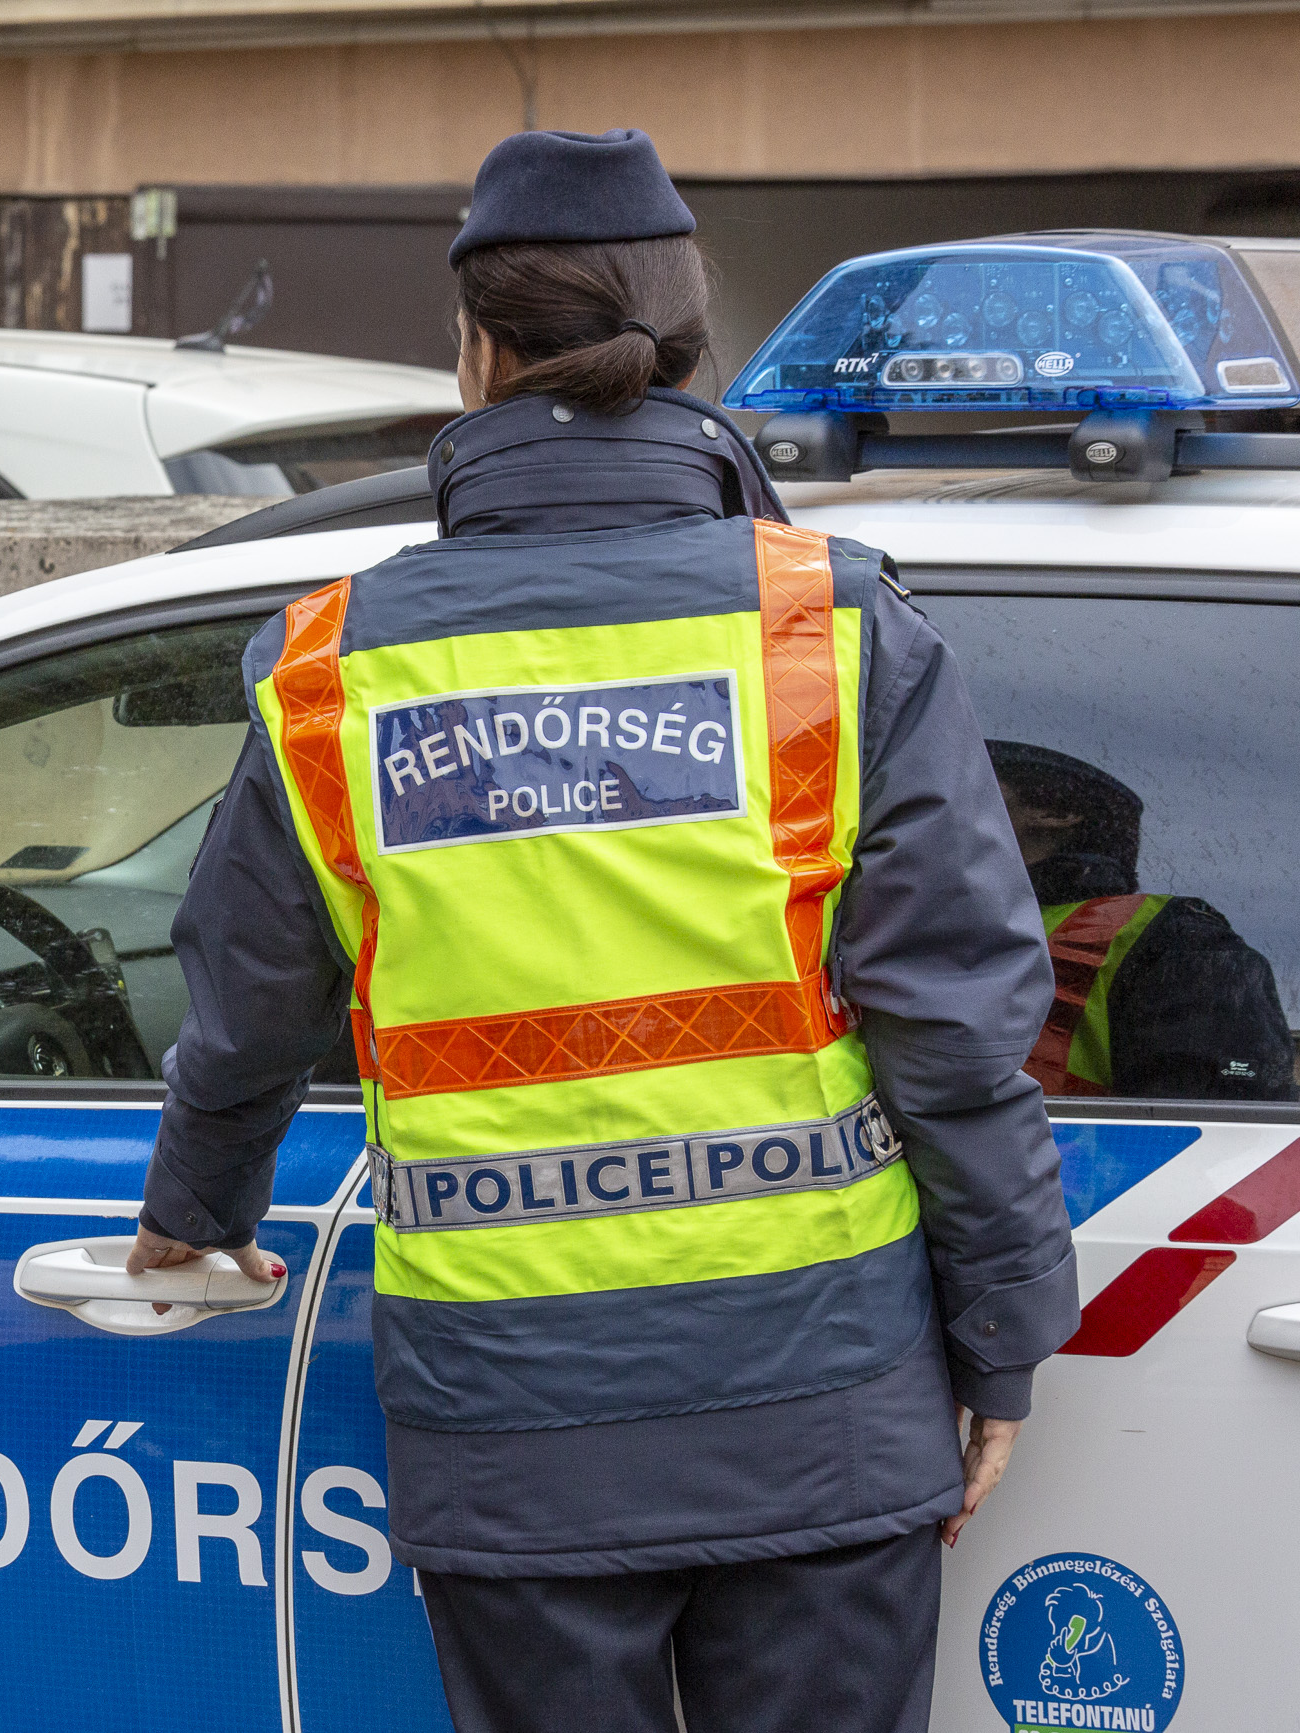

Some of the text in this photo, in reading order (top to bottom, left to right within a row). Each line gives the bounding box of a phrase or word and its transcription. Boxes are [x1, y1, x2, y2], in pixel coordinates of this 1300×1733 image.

[1036, 355, 1075, 371] HELLA
[770, 446, 799, 459] HELLA
[1086, 445, 1118, 459] HELLA
[382, 695, 728, 796] RENDŐRSÉG
[487, 778, 623, 821] POLICE
[425, 1149, 676, 1218] POLICE
[984, 1559, 1180, 1701] Rendőrség Bűnmegelőzési Szolgálata
[1012, 1699, 1155, 1732] TELEFONTANÚ
